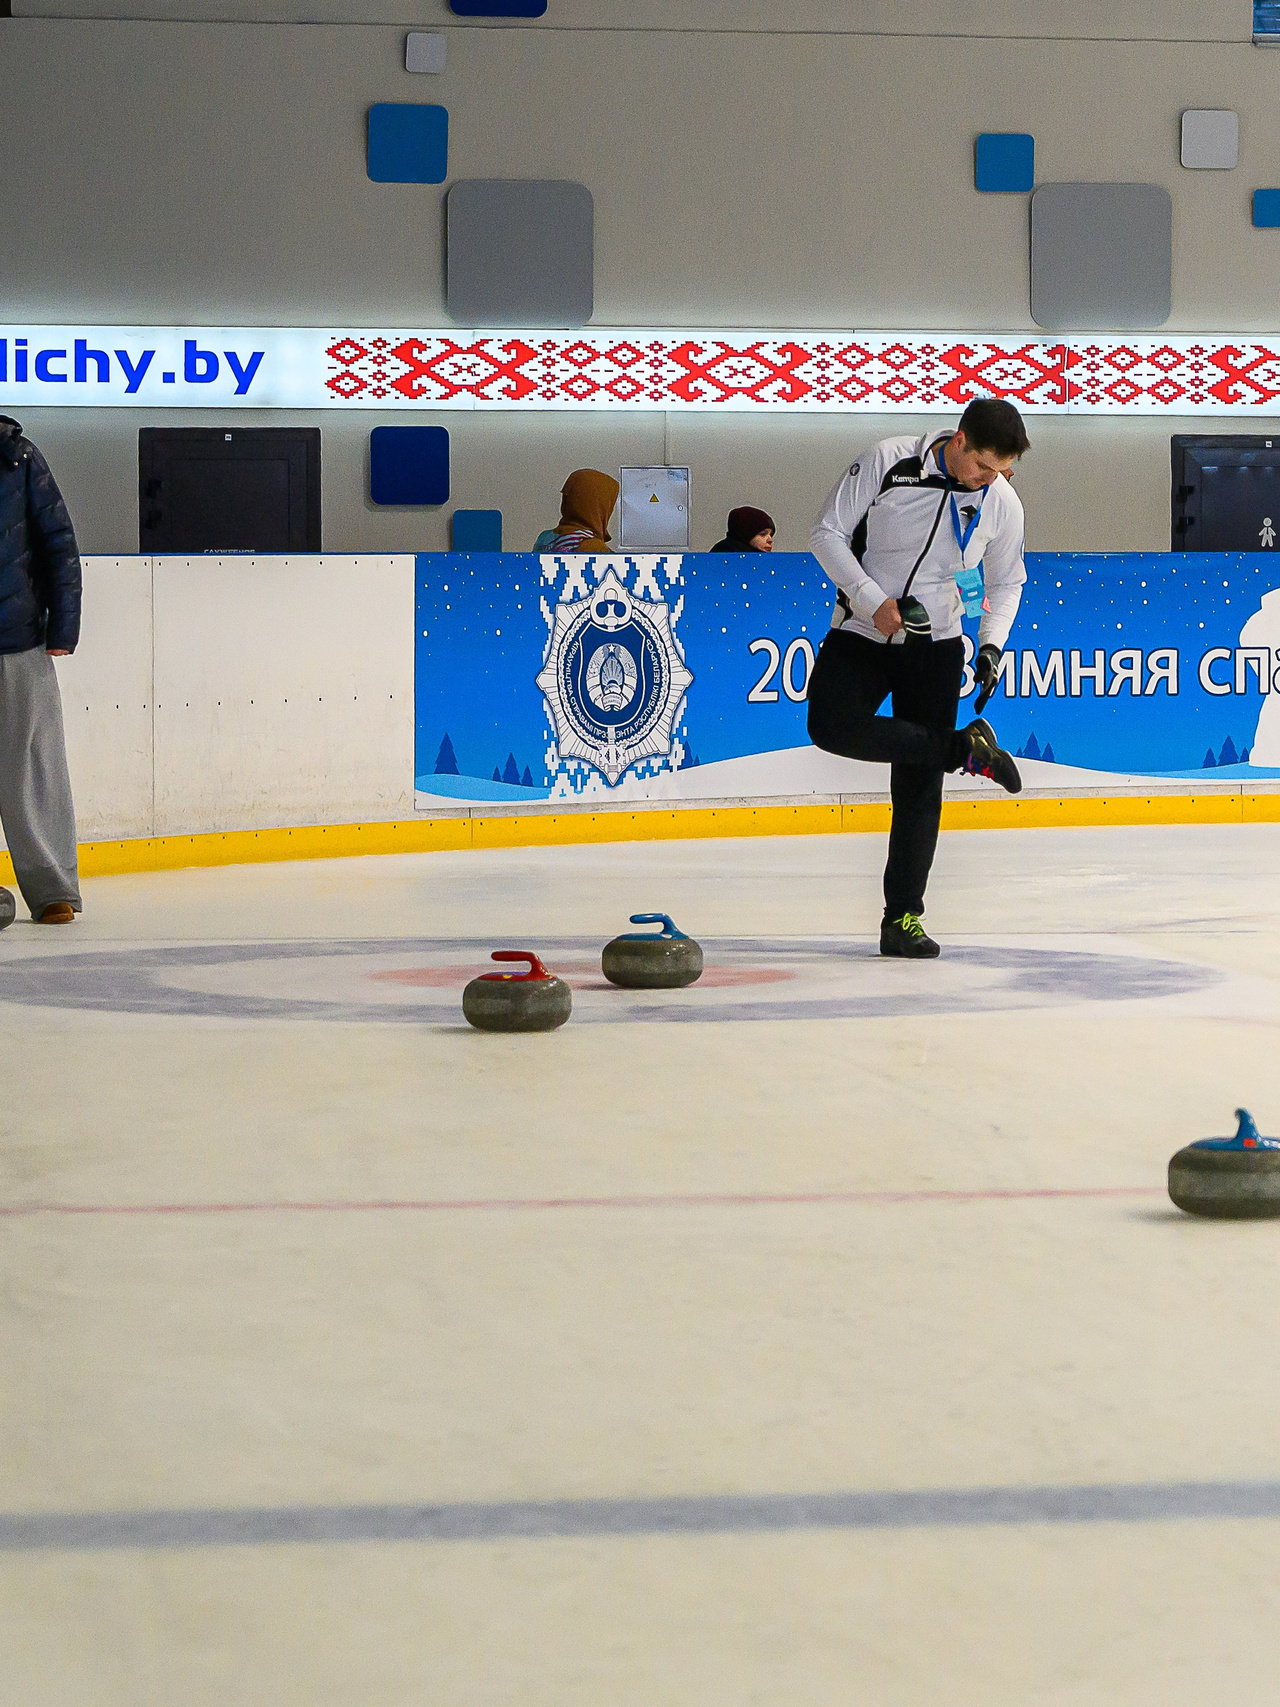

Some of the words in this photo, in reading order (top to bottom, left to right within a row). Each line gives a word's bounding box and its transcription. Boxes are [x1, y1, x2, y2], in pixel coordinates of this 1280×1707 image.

[891, 474, 920, 485] Kempa
[645, 638, 661, 685] БЕЛАРУСЬ
[747, 637, 824, 702] 20
